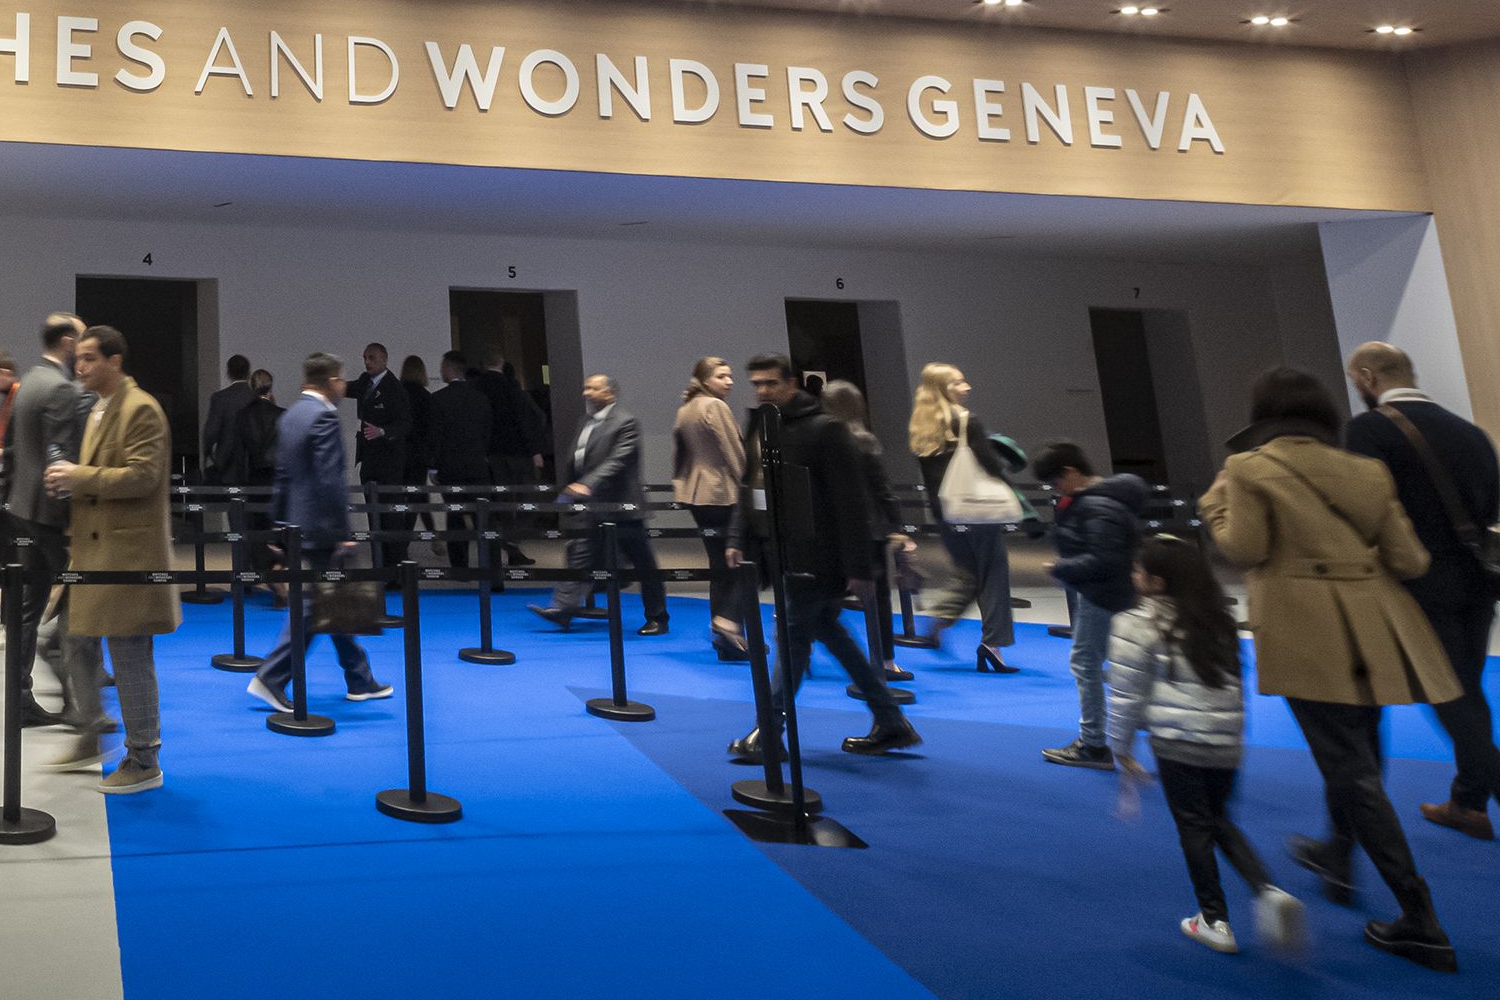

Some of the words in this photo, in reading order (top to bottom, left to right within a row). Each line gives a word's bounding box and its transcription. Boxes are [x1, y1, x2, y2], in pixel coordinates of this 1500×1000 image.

[194, 26, 401, 104] AND
[424, 40, 886, 134] WONDERS
[907, 74, 1227, 154] GENEVA
[142, 252, 153, 266] 4
[508, 265, 517, 279] 5
[836, 278, 845, 290] 6
[1133, 287, 1140, 299] 7
